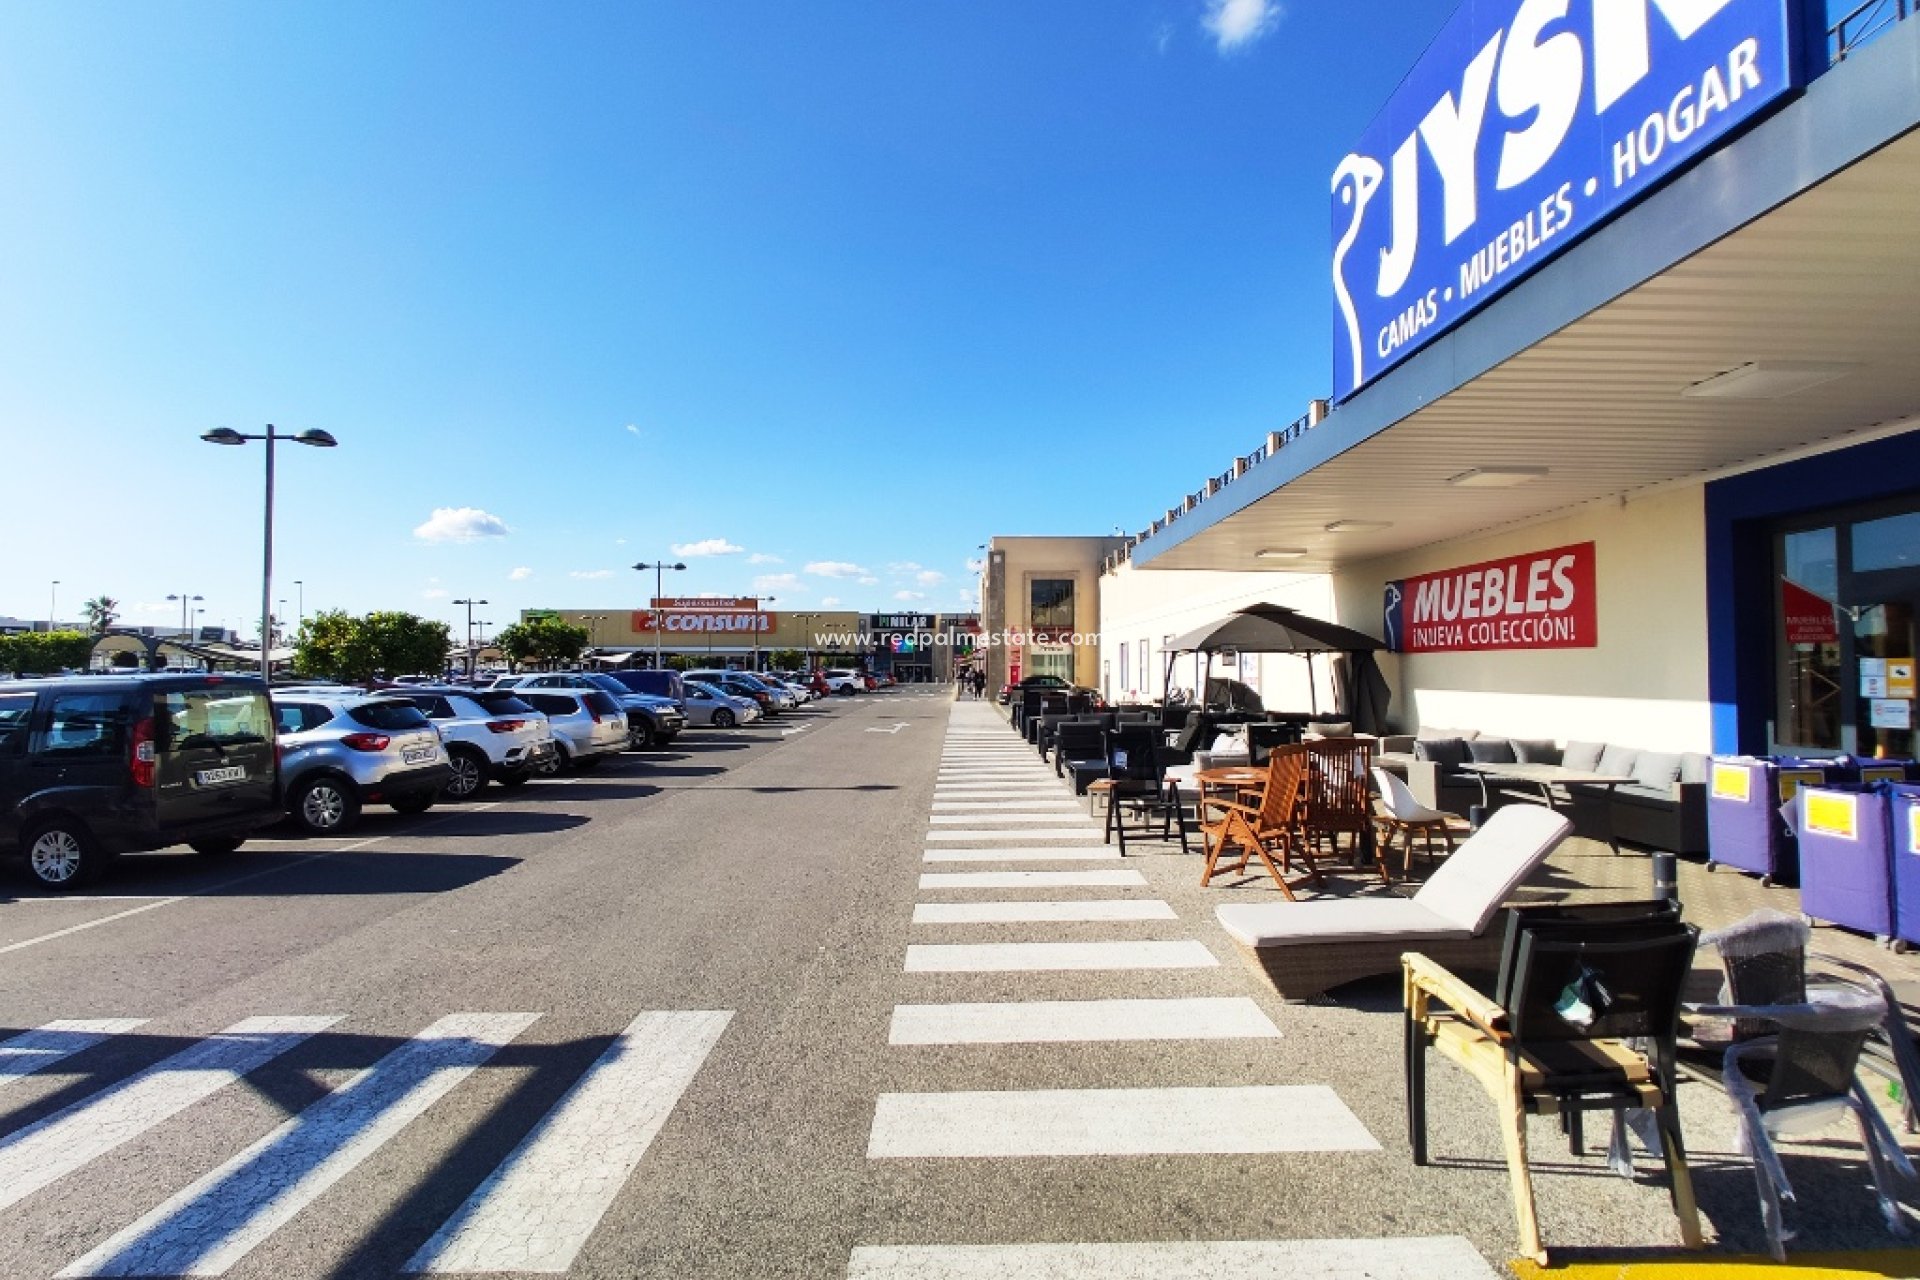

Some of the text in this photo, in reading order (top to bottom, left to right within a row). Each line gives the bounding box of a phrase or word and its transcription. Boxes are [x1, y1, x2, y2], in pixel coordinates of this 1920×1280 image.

[1377, 37, 1760, 358] CAMAS MUEBLES HOGAR
[1413, 554, 1576, 624] MUEBLES
[1468, 612, 1576, 644] COLECCIÓN!
